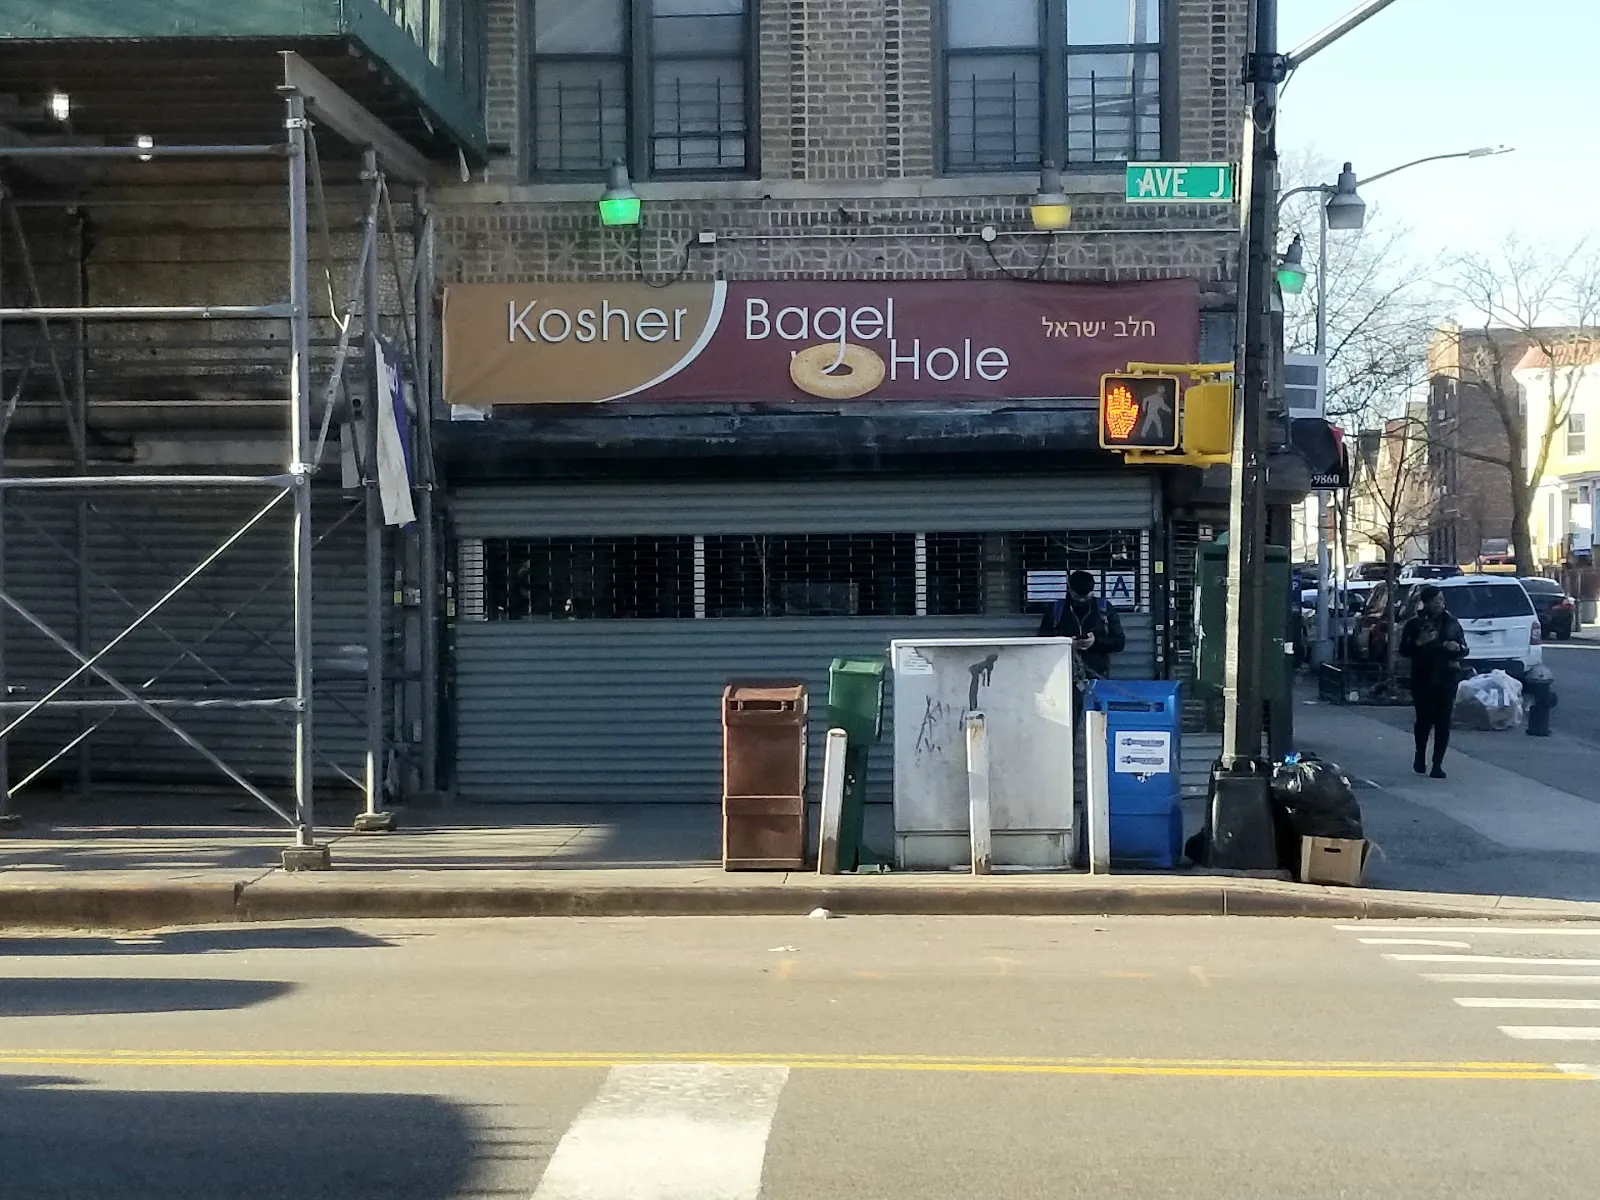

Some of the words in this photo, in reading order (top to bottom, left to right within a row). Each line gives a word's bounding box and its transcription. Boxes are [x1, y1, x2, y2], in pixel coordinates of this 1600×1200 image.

[1138, 168, 1188, 197] AVE
[1209, 168, 1224, 197] J
[508, 300, 687, 343] Kosher
[746, 298, 893, 374] Bagel
[1042, 316, 1106, 337] ישראל
[1114, 315, 1155, 337] חלב
[890, 339, 1009, 380] Hole
[1111, 575, 1130, 597] A
